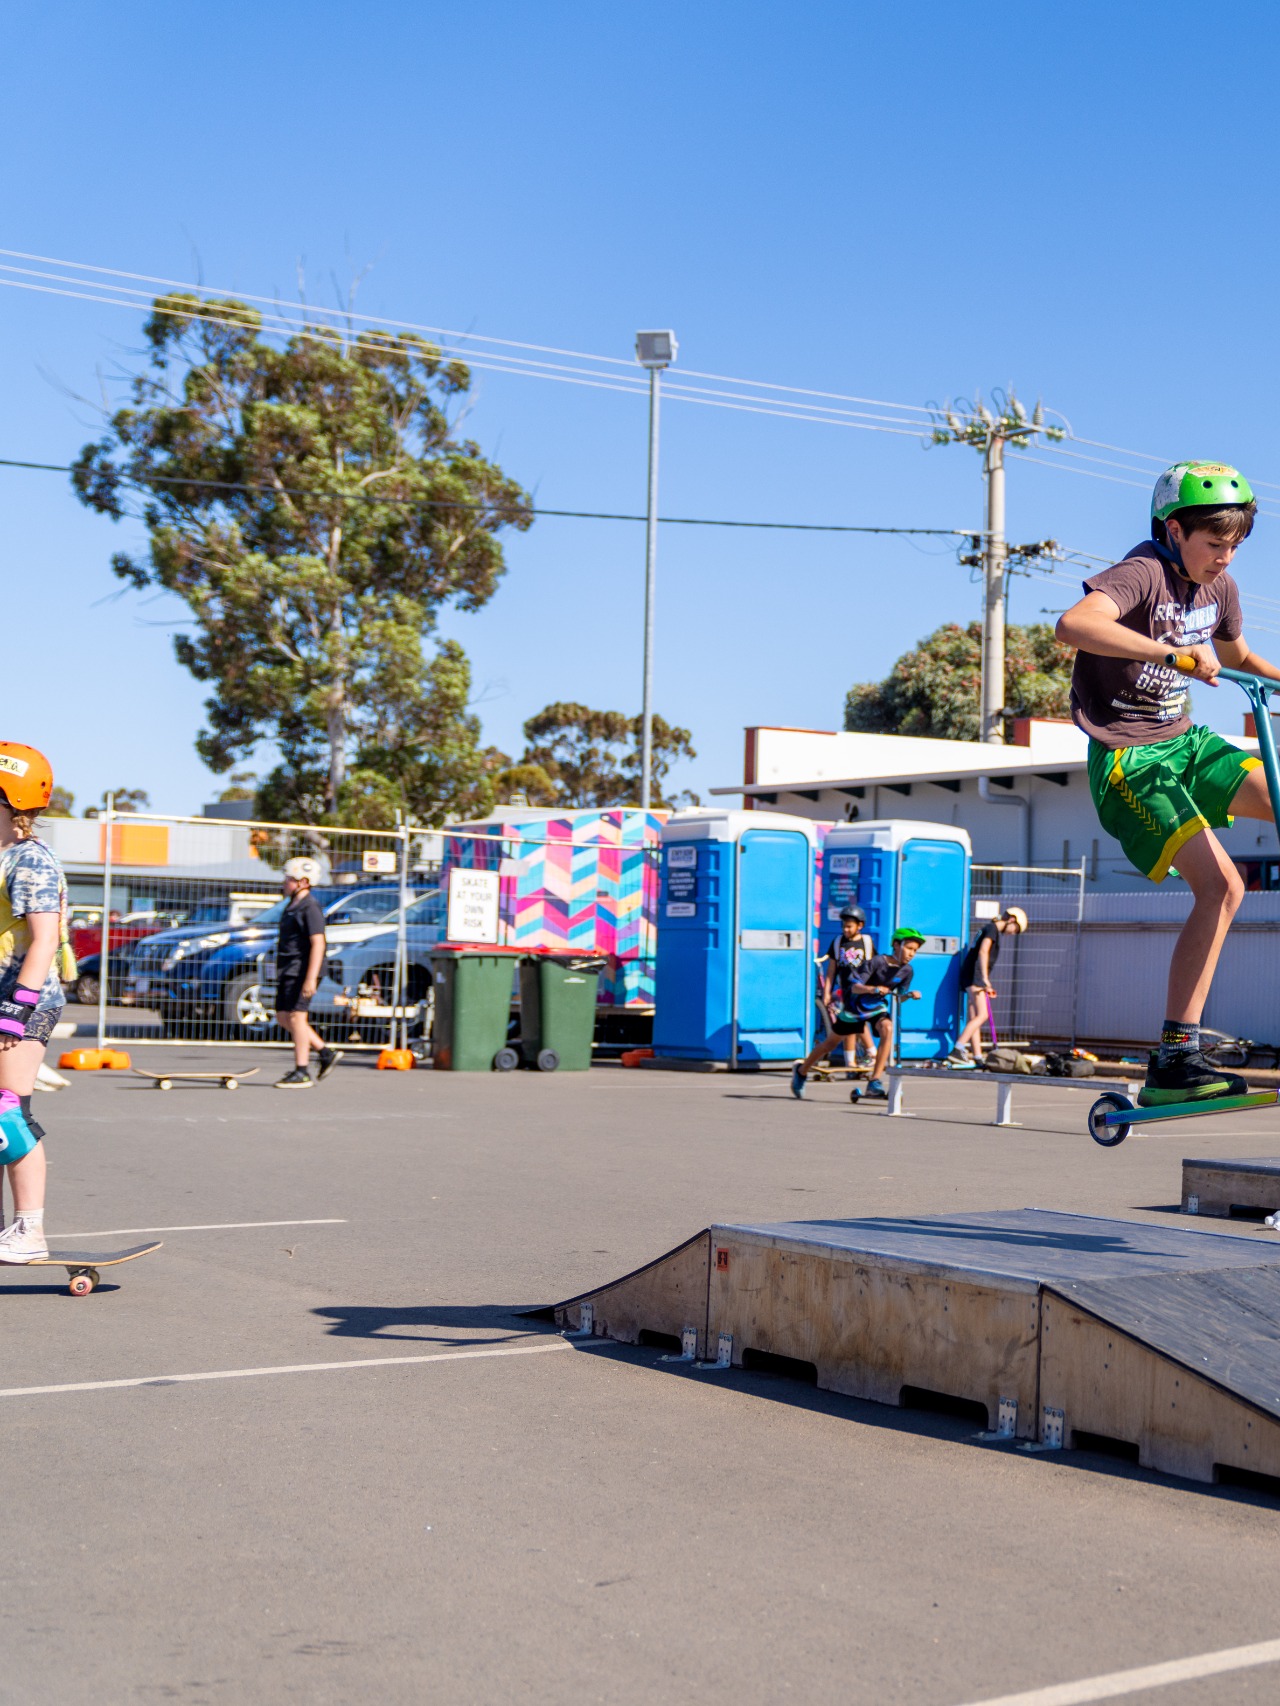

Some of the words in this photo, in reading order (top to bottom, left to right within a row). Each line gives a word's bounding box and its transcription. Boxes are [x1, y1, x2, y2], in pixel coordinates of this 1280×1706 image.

[462, 877, 488, 888] SKATE
[456, 890, 466, 899] AT
[470, 891, 493, 902] YOUR
[463, 904, 484, 914] OWN
[463, 918, 483, 928] RISK
